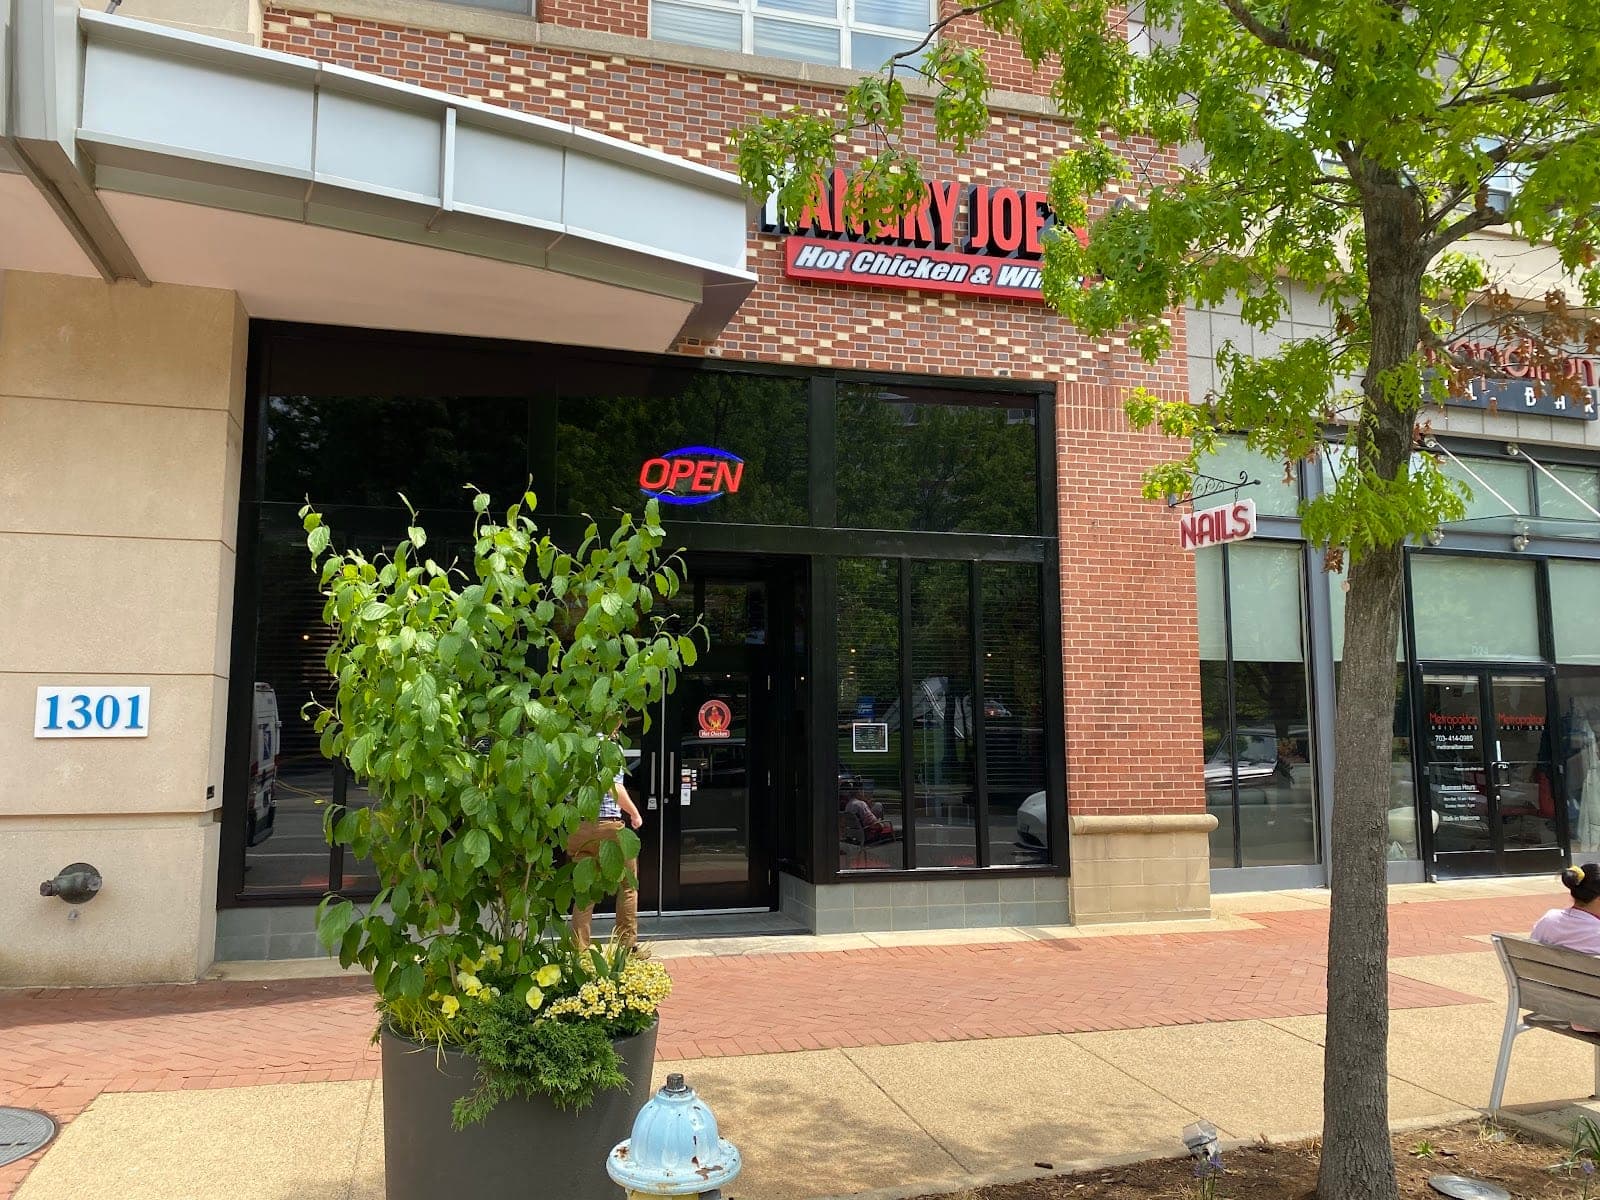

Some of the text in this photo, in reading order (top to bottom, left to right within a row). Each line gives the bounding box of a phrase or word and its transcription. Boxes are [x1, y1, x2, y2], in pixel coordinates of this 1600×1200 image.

[971, 184, 1089, 255] JOE
[795, 245, 851, 271] Hot
[852, 251, 969, 283] Chicken
[970, 266, 992, 285] &
[640, 458, 744, 493] OPEN
[1181, 505, 1250, 548] NAILS
[43, 694, 143, 730] 1301
